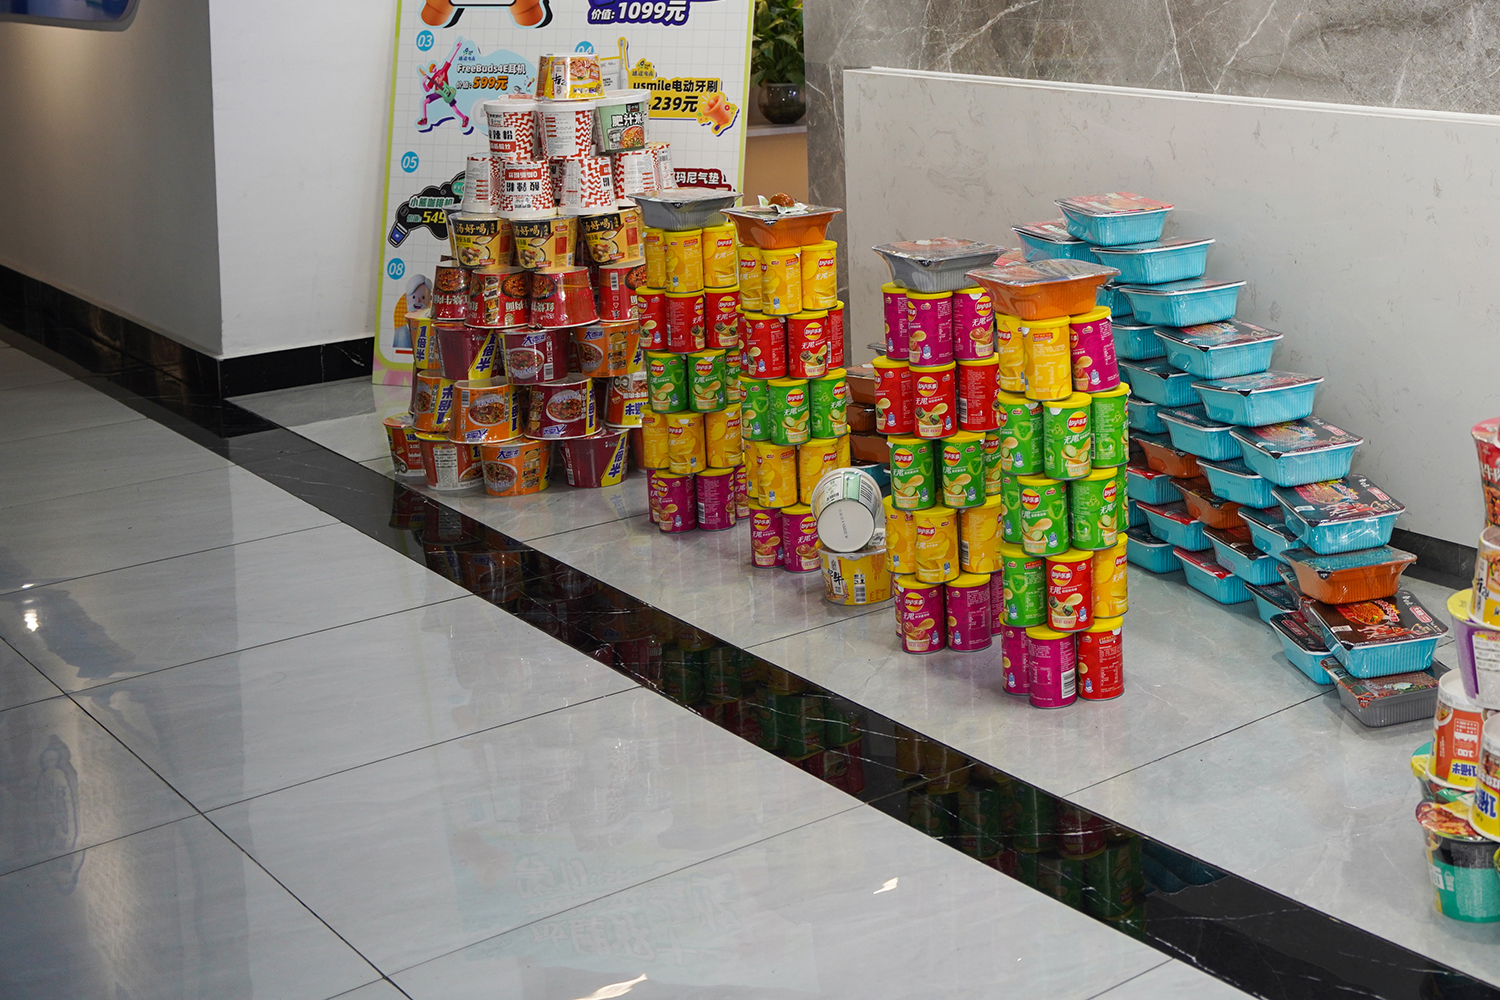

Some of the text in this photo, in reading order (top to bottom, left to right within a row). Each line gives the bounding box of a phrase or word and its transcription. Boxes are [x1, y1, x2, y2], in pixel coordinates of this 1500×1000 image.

[618, 0, 687, 22] 1099元
[417, 35, 433, 48] 03
[457, 63, 526, 75] FreeBuds4E耳机
[472, 75, 508, 90] 599元
[632, 80, 719, 94] usmile电动牙刷
[402, 156, 418, 169] 05
[387, 263, 404, 276] 08
